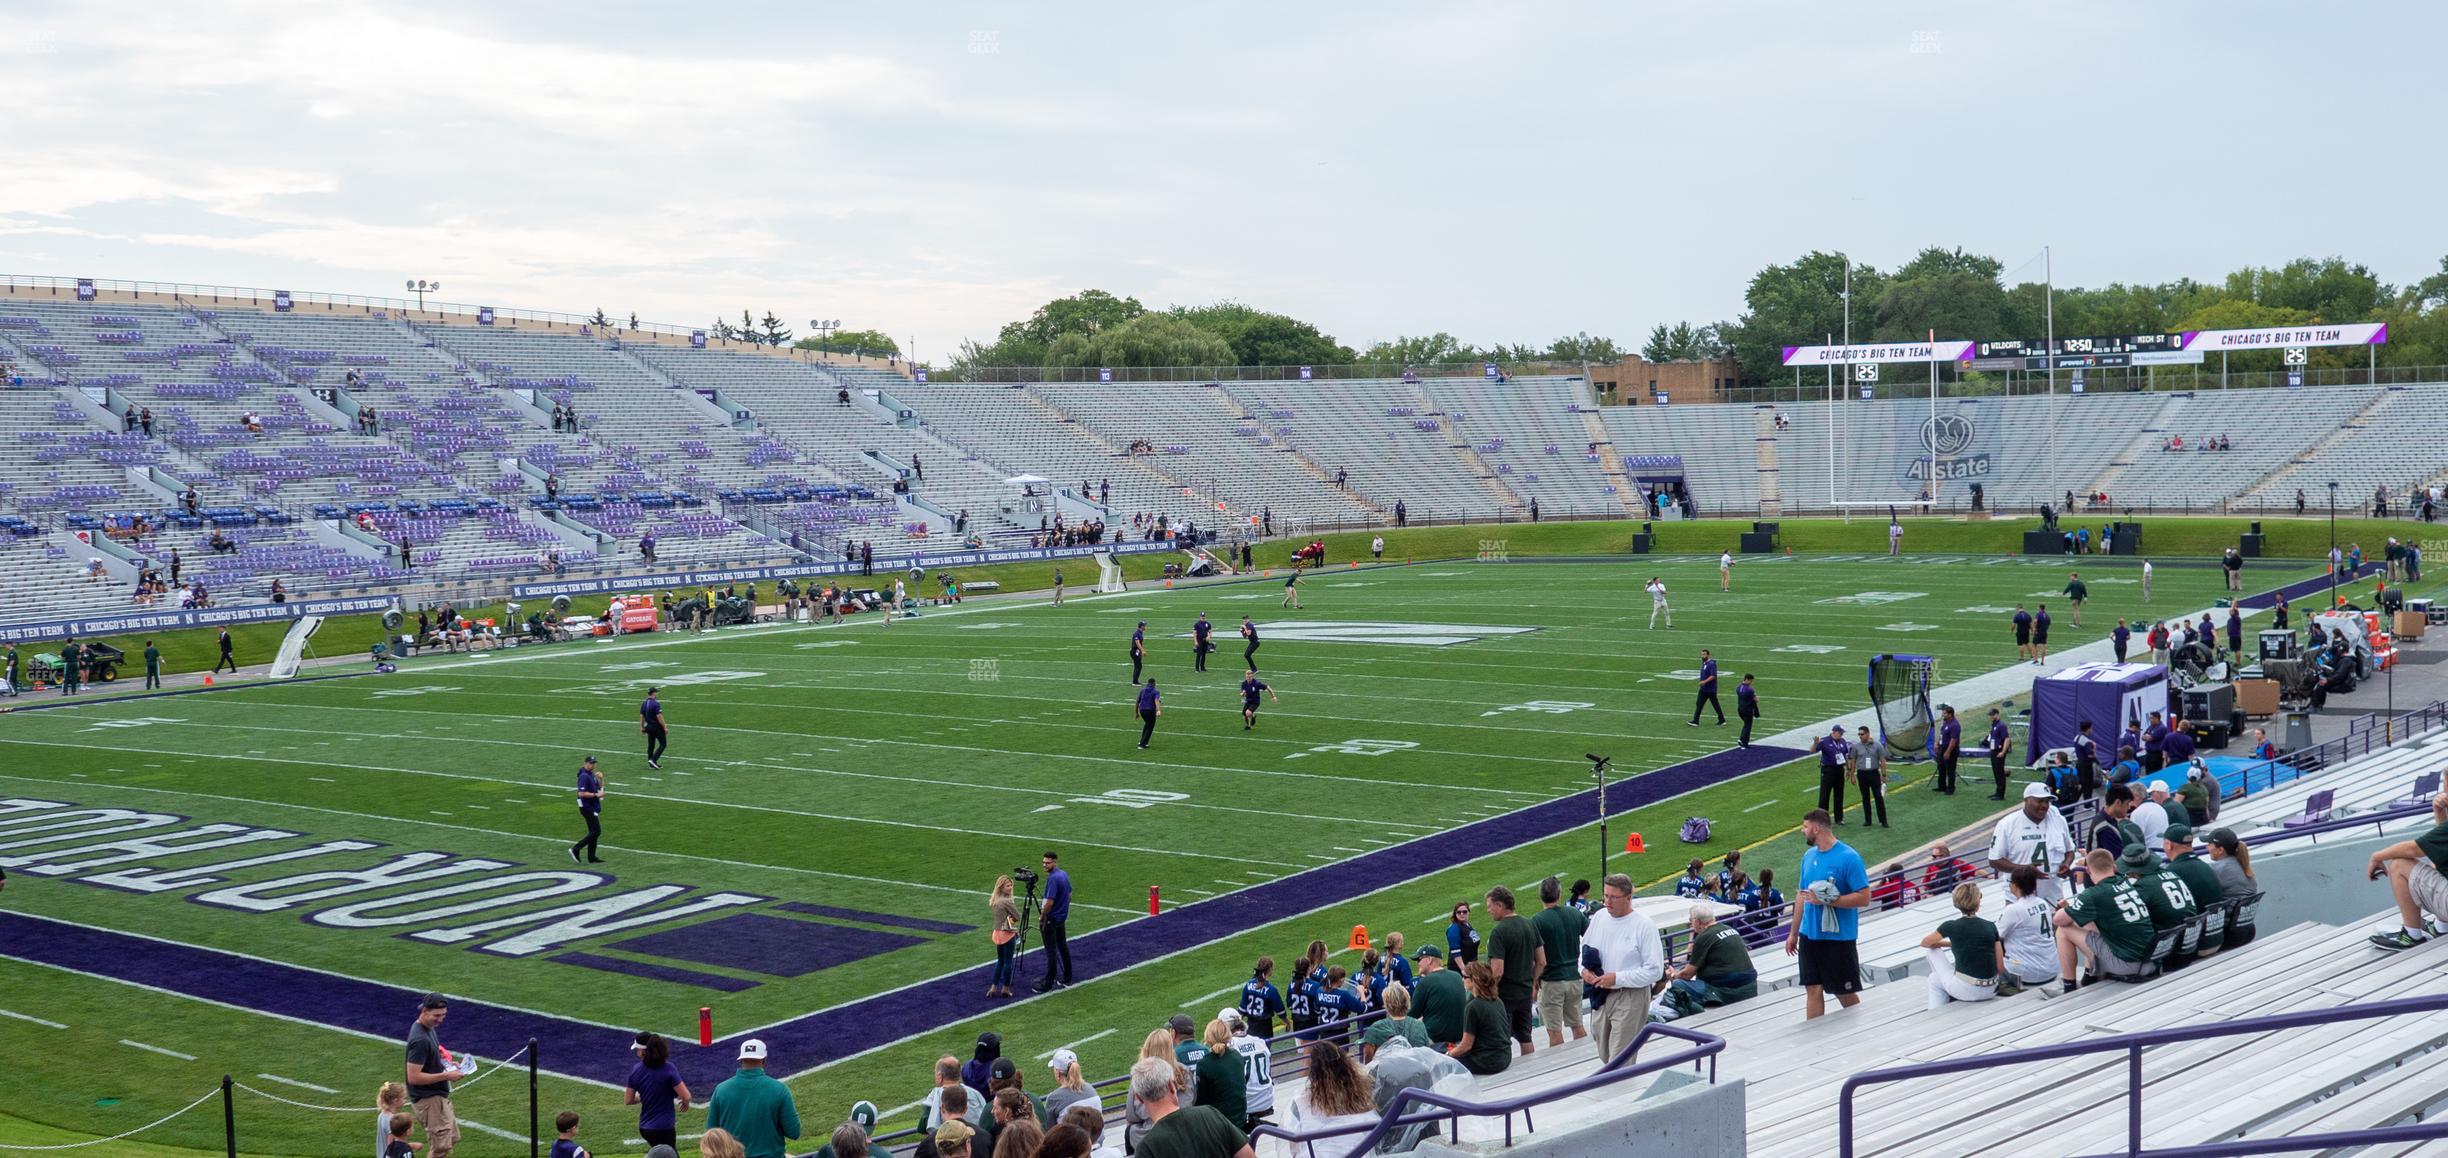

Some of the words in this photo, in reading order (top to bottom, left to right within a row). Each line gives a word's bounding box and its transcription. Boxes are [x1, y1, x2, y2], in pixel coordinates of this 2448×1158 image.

[1990, 341, 2021, 349] WILDCATS
[2174, 336, 2181, 347] 0
[2221, 334, 2270, 345] CHICAGO'S
[2274, 333, 2290, 342] BIG
[2295, 332, 2311, 342] TEN
[2315, 330, 2340, 341] TEAM
[1870, 349, 1885, 358] BIG
[1889, 348, 1904, 358] TEN
[1908, 346, 1932, 357] TEAM
[1982, 344, 1989, 355] 0
[2287, 349, 2304, 362] 25
[1858, 366, 1876, 379] 25
[1908, 457, 1988, 480] Allstate
[8, 628, 22, 639] BIG
[23, 627, 39, 638] TEN
[40, 625, 64, 636] TEAM
[71, 623, 79, 634] N
[86, 619, 126, 632] CHICAGO'S
[127, 618, 140, 628] BIG
[141, 617, 157, 627] TEN
[158, 615, 180, 626] TEAM
[186, 613, 194, 624] N
[200, 610, 237, 622] CHICAGO'S
[238, 609, 250, 619] BIG
[251, 608, 266, 618] TEN
[267, 606, 288, 617] TEAM
[293, 604, 300, 615] N
[305, 602, 342, 614] CHICAGO'S
[342, 601, 354, 611] BIG
[354, 600, 369, 610] TEN
[369, 598, 389, 608] TEAM
[1632, 837, 1640, 846] 10
[2031, 842, 2050, 872] 4
[2161, 878, 2196, 910] 64
[2114, 890, 2149, 922] 55
[2040, 913, 2050, 938] 4
[1355, 934, 1364, 945] G
[1246, 995, 1264, 1016] 23
[1292, 994, 1310, 1015] 23
[1318, 993, 1341, 1004] VARSITY
[1320, 1007, 1340, 1023] 22
[1238, 1042, 1256, 1052] HIGBY
[1244, 1053, 1271, 1085] 70
